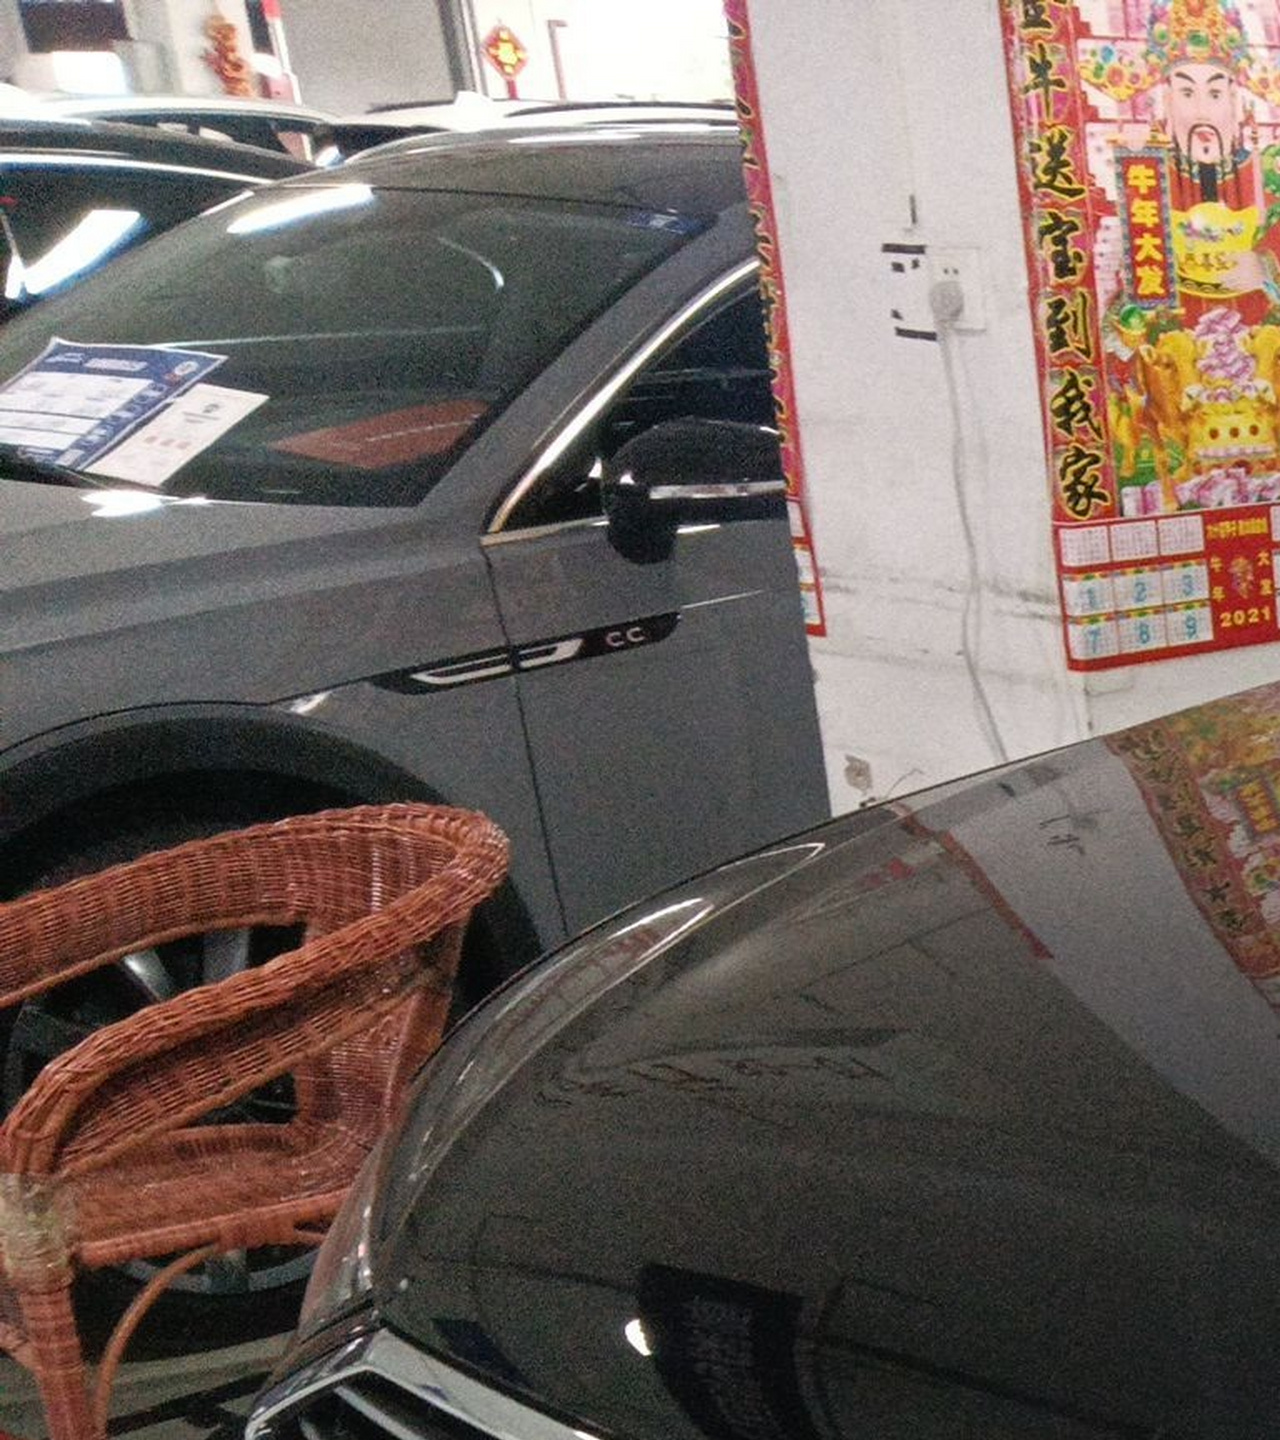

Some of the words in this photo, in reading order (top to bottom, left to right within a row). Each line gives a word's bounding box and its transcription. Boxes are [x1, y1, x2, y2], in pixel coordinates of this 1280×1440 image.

[1126, 164, 1166, 295] 牛年大发
[1134, 581, 1148, 603] 2
[1182, 574, 1195, 596] 3
[1220, 605, 1271, 628] 2021
[605, 626, 646, 648] CC
[1087, 628, 1101, 654] 7
[1139, 622, 1151, 645] 8
[1184, 615, 1198, 640] 9
